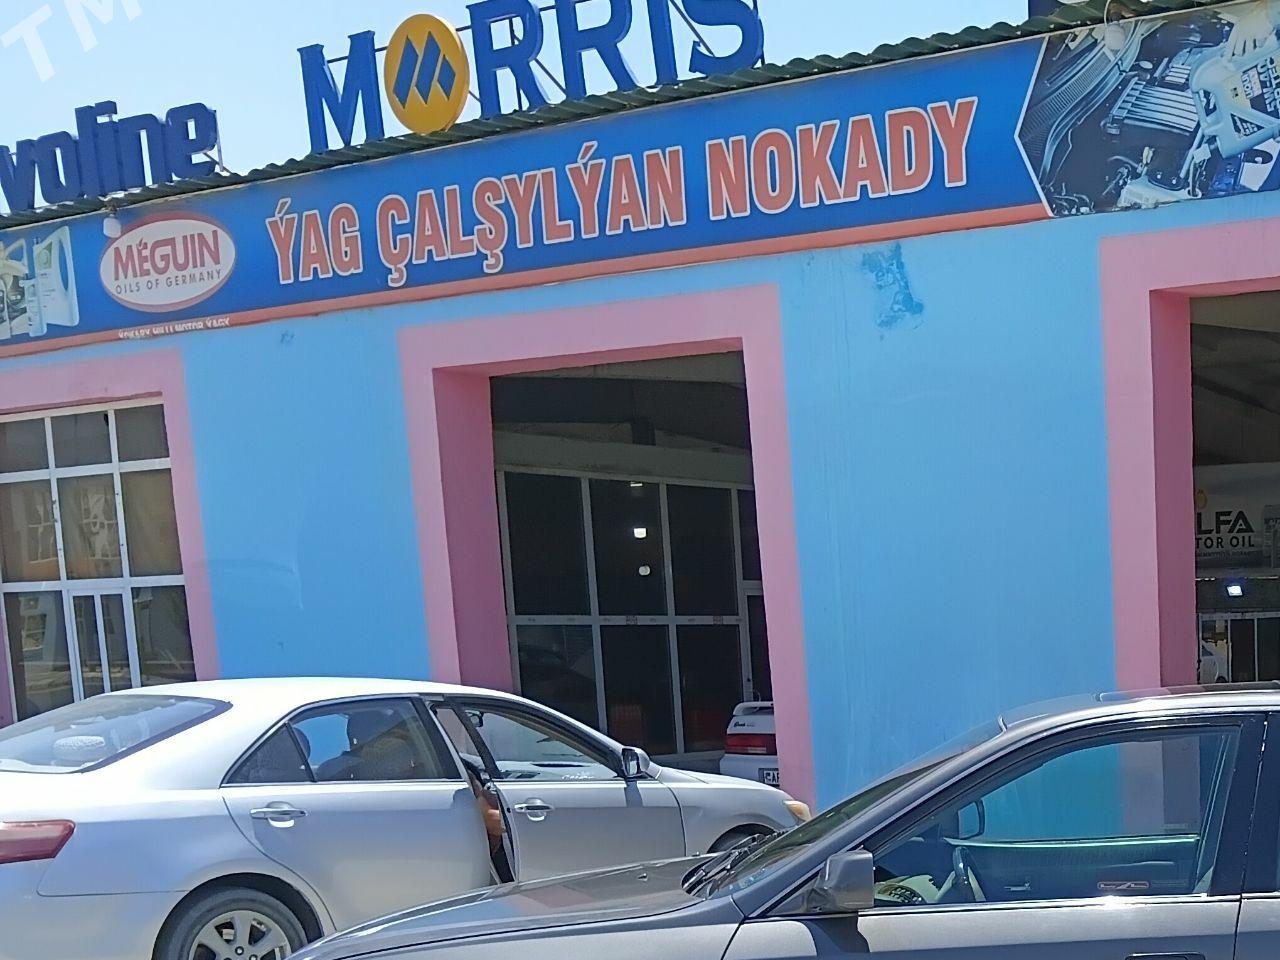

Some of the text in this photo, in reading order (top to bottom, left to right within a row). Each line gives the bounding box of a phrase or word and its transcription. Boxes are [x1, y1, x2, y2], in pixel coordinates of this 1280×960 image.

[266, 96, 978, 287] ÝAG ÇALŞYLÝAN NOKADY
[115, 268, 222, 295] OILS OF GERMANY
[1230, 535, 1255, 549] OIL
